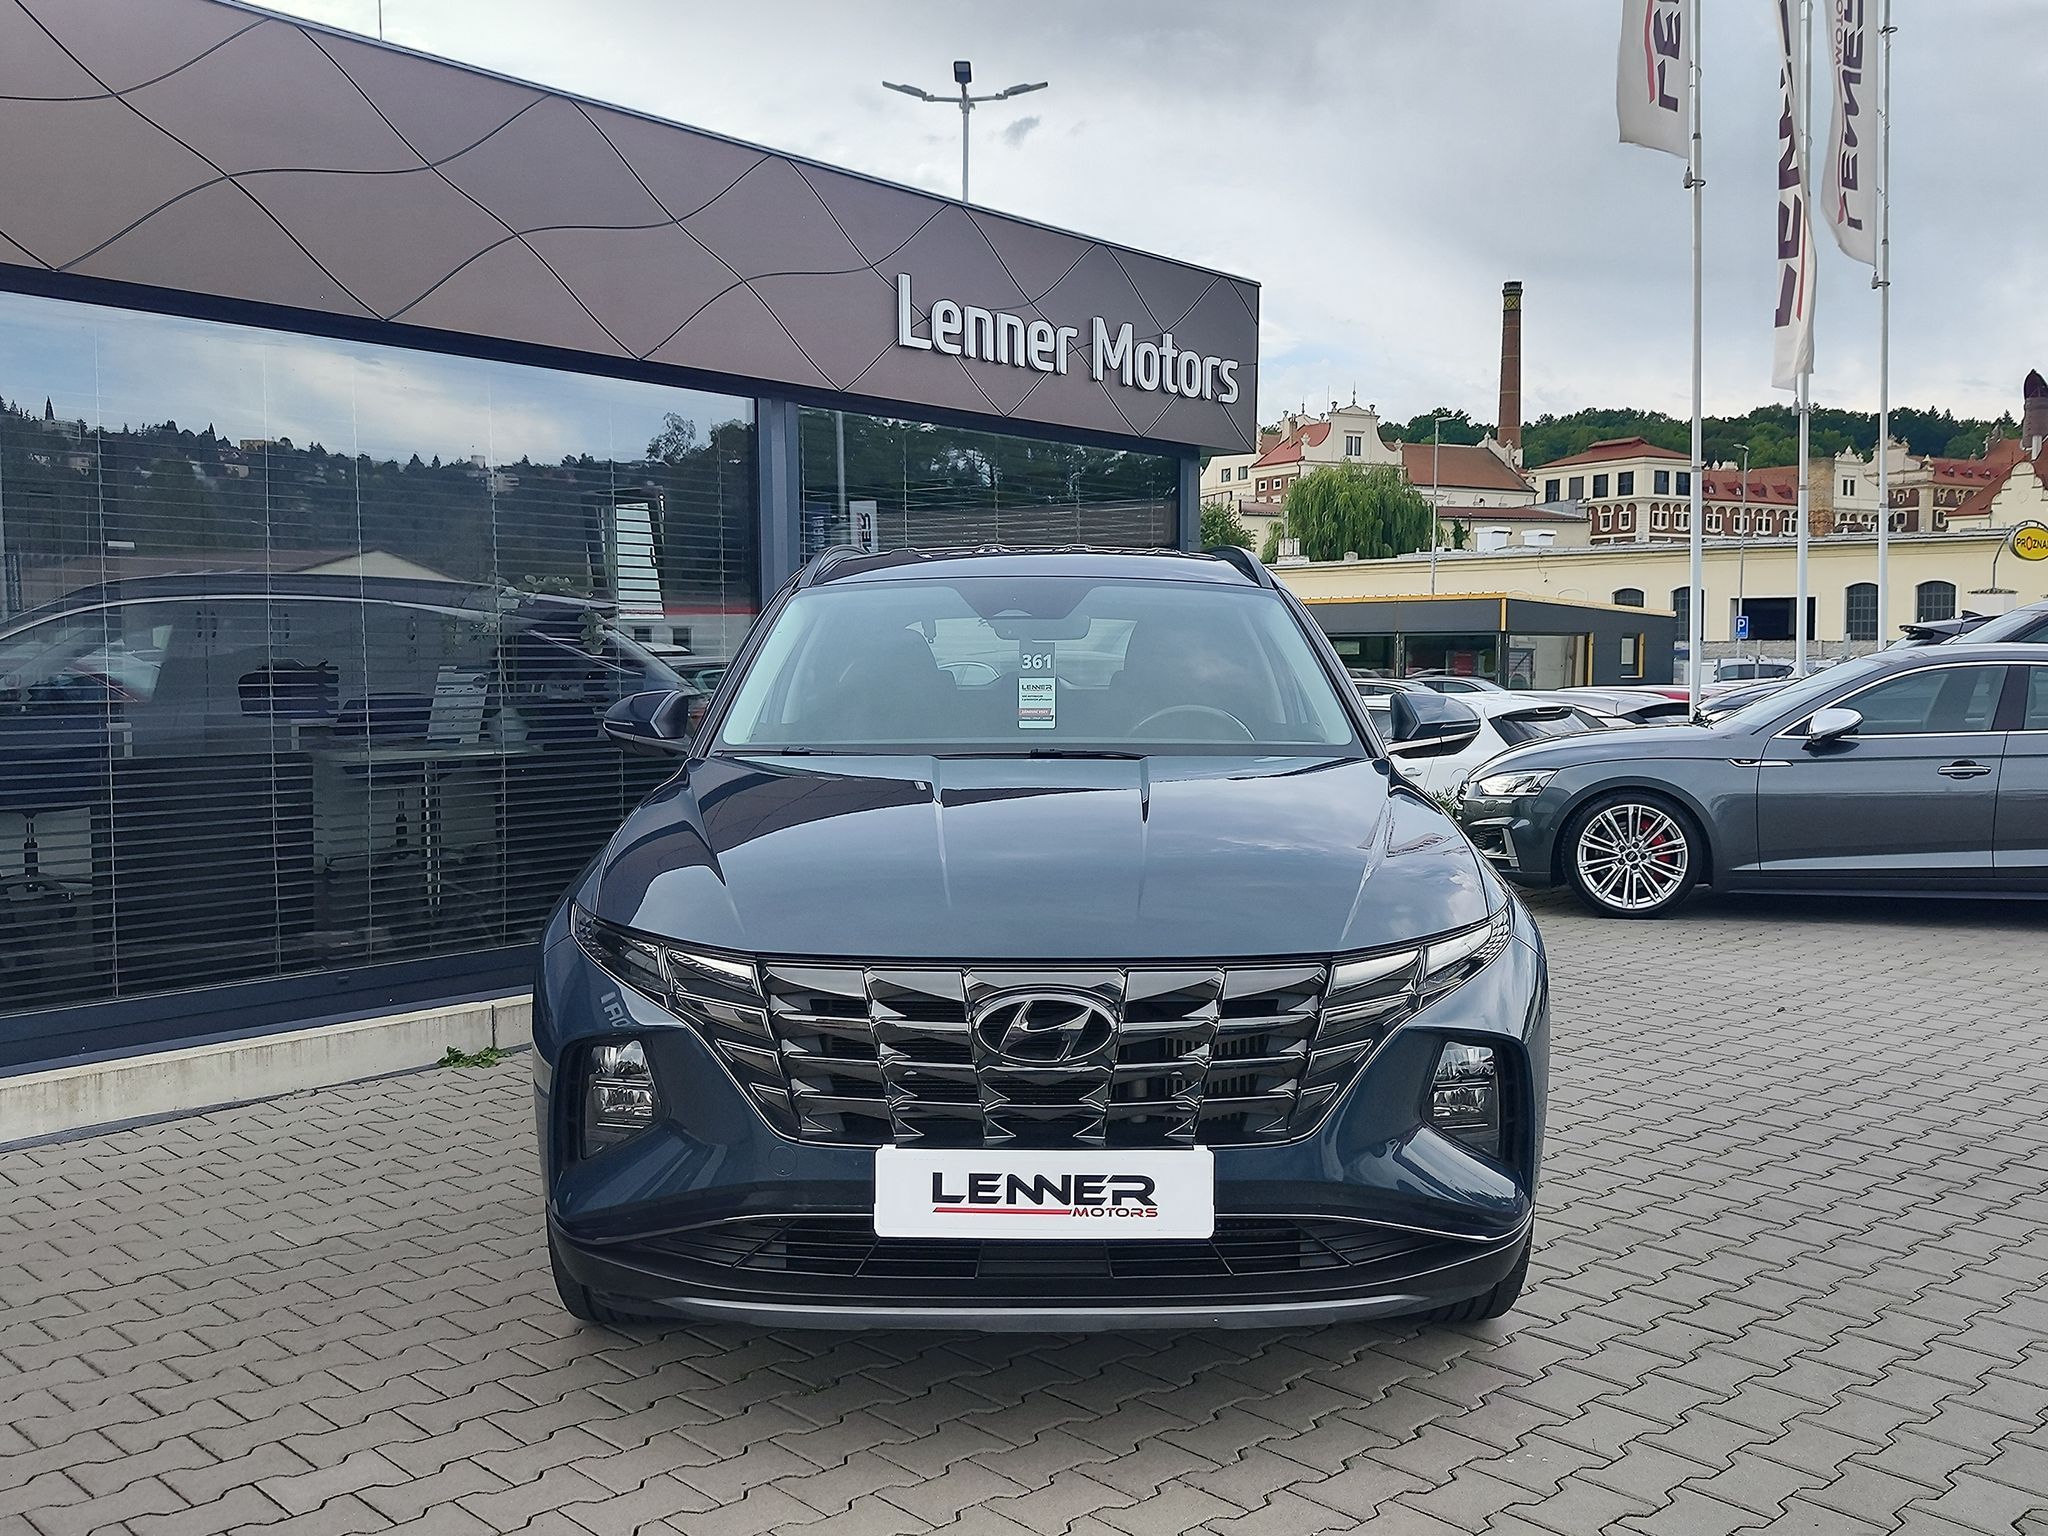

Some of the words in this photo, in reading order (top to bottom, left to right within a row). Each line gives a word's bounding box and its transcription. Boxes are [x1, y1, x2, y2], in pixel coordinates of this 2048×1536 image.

[897, 272, 1079, 376] Lenner
[1091, 316, 1240, 405] Motors
[1737, 618, 1746, 632] P
[1021, 654, 1052, 669] 361
[931, 1172, 1159, 1206] LENNER
[1072, 1207, 1159, 1218] MOTORS
